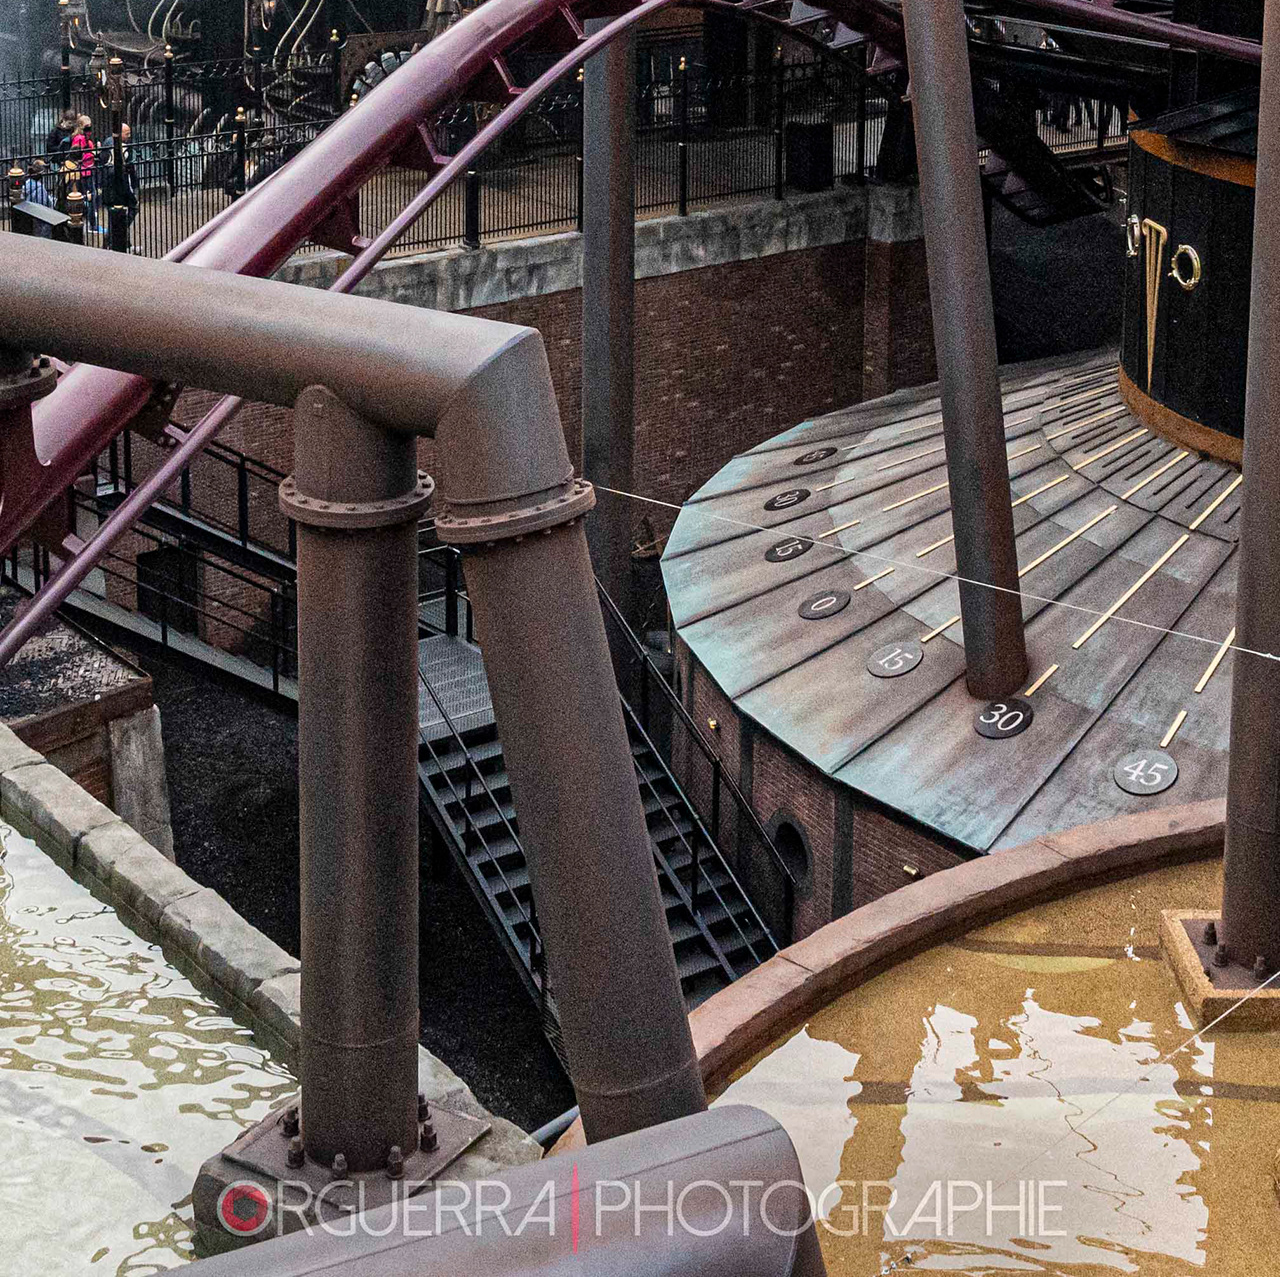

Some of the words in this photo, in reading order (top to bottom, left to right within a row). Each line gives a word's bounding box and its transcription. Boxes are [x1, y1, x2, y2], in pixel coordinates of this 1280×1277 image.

[774, 490, 800, 508] 30
[775, 539, 804, 558] 15
[811, 596, 837, 611] 0
[877, 647, 914, 671] 15
[978, 702, 1025, 732] 30
[1122, 756, 1169, 787] 45
